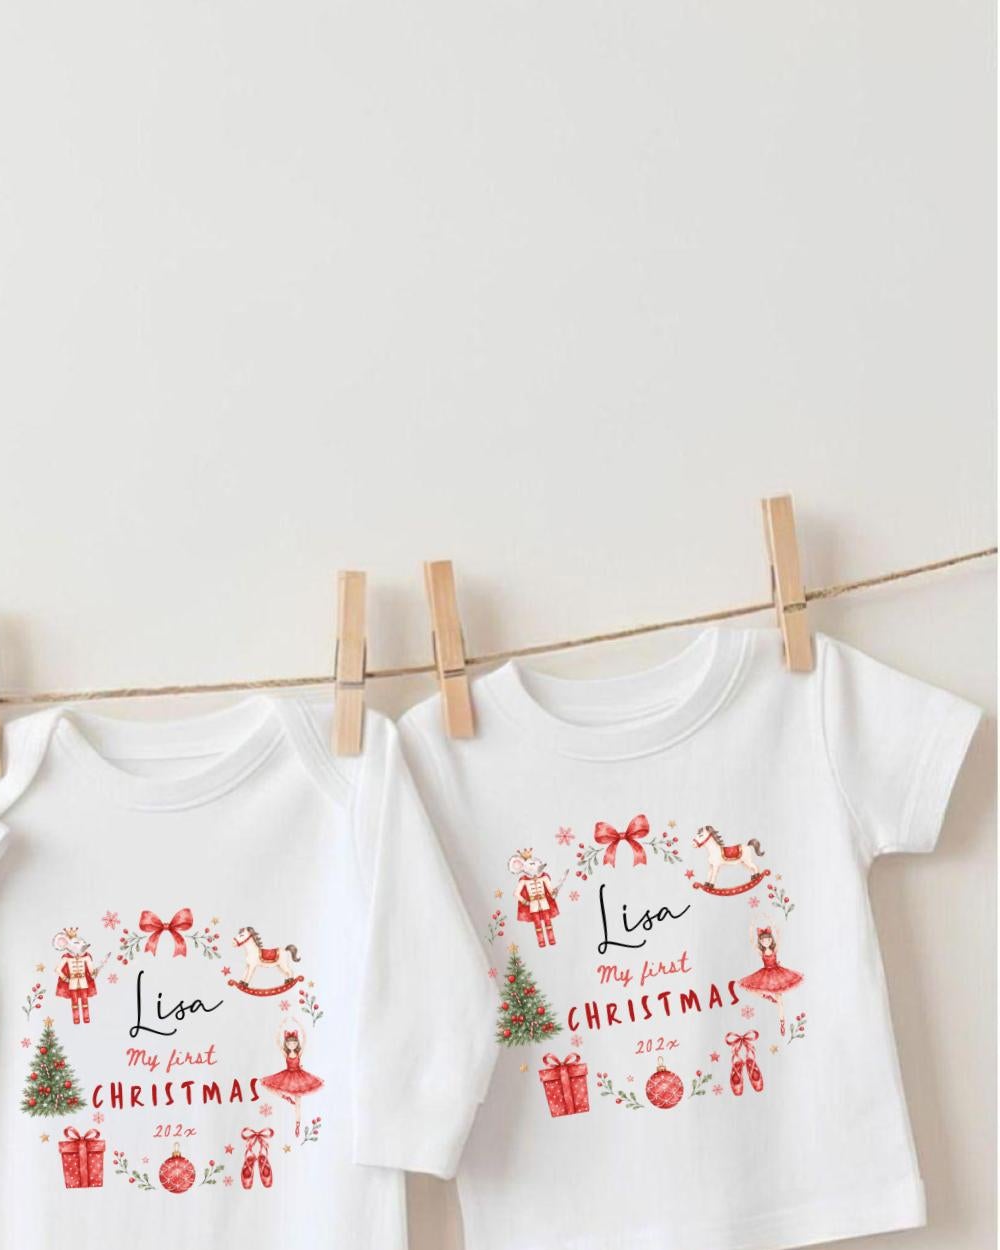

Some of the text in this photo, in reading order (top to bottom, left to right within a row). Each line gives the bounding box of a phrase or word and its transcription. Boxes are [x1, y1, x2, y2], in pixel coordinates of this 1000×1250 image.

[597, 883, 691, 954] Lisa
[596, 950, 692, 988] My first
[129, 970, 224, 1038] Lisa
[567, 980, 741, 1032] CHRISTMAS
[126, 1044, 218, 1073] My first
[634, 1037, 680, 1054] 202x
[91, 1078, 261, 1110] CHRISTMAS
[152, 1123, 197, 1138] 202x
